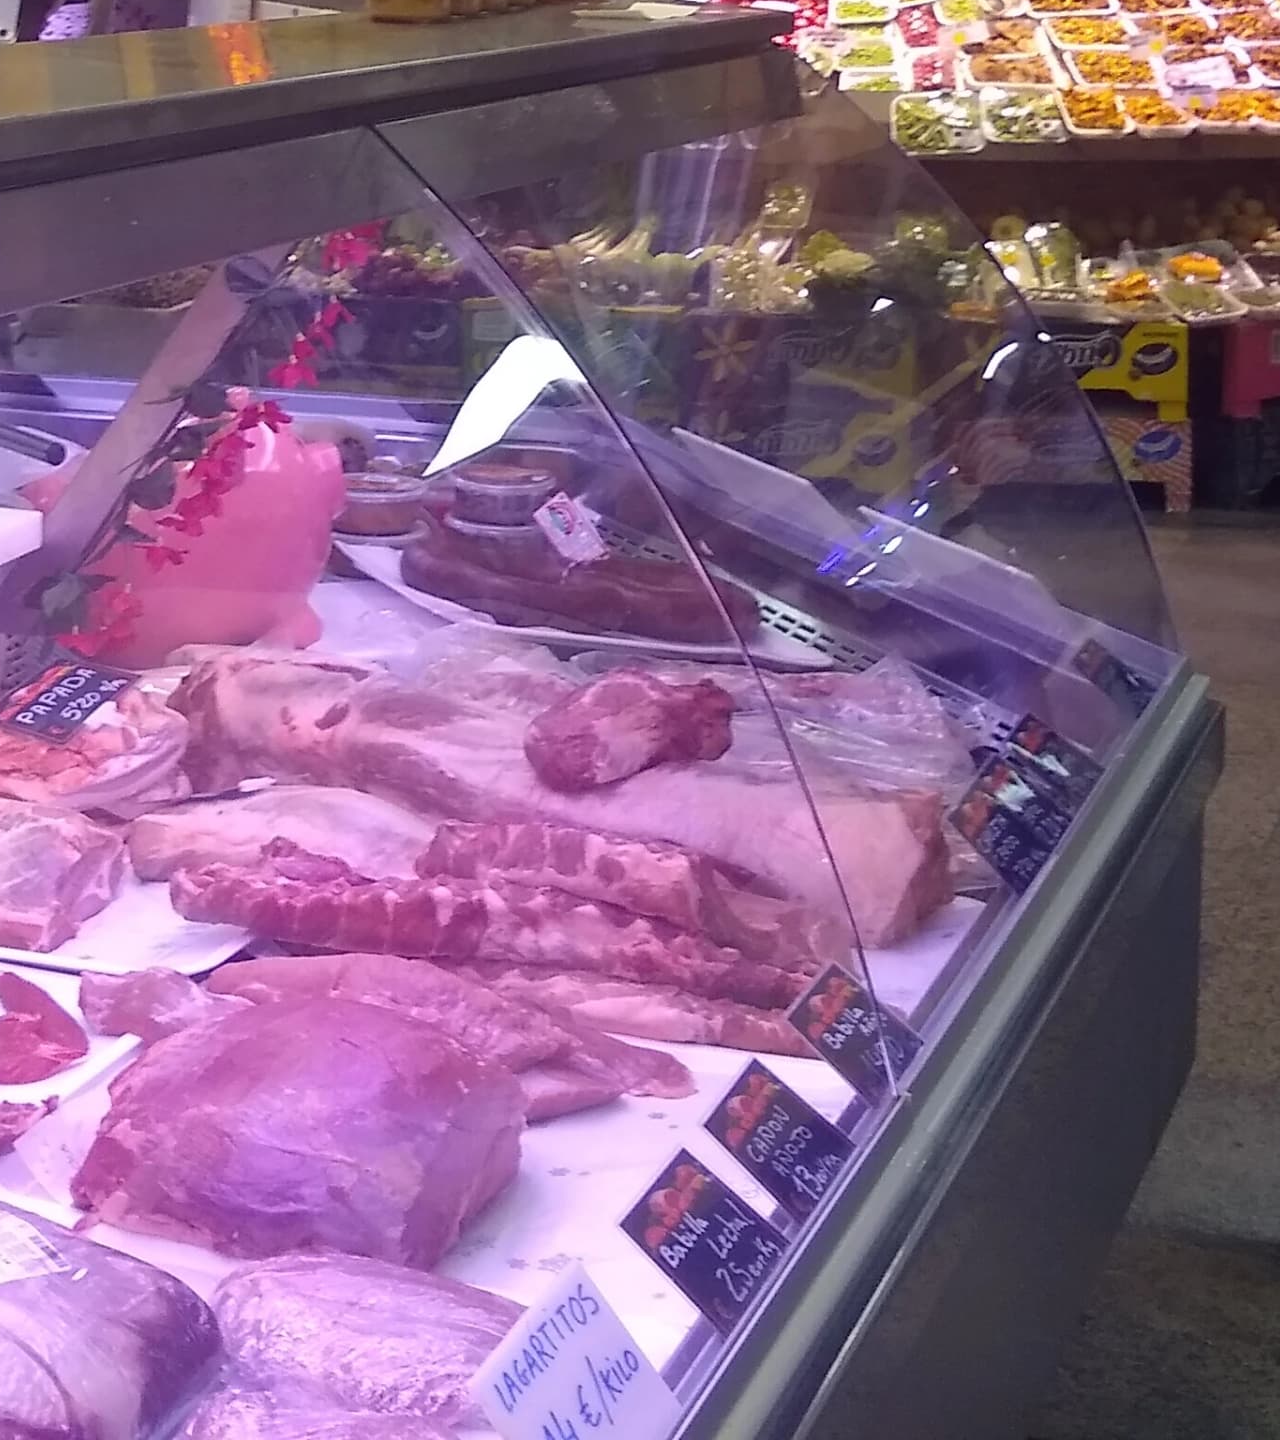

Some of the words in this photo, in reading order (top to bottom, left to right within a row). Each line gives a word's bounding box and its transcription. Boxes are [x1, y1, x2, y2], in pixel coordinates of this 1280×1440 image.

[15, 667, 97, 725] PAPADA
[822, 1007, 865, 1050] Babilla
[659, 1211, 710, 1269] Babilla
[493, 1283, 600, 1413] LAGARTITOS
